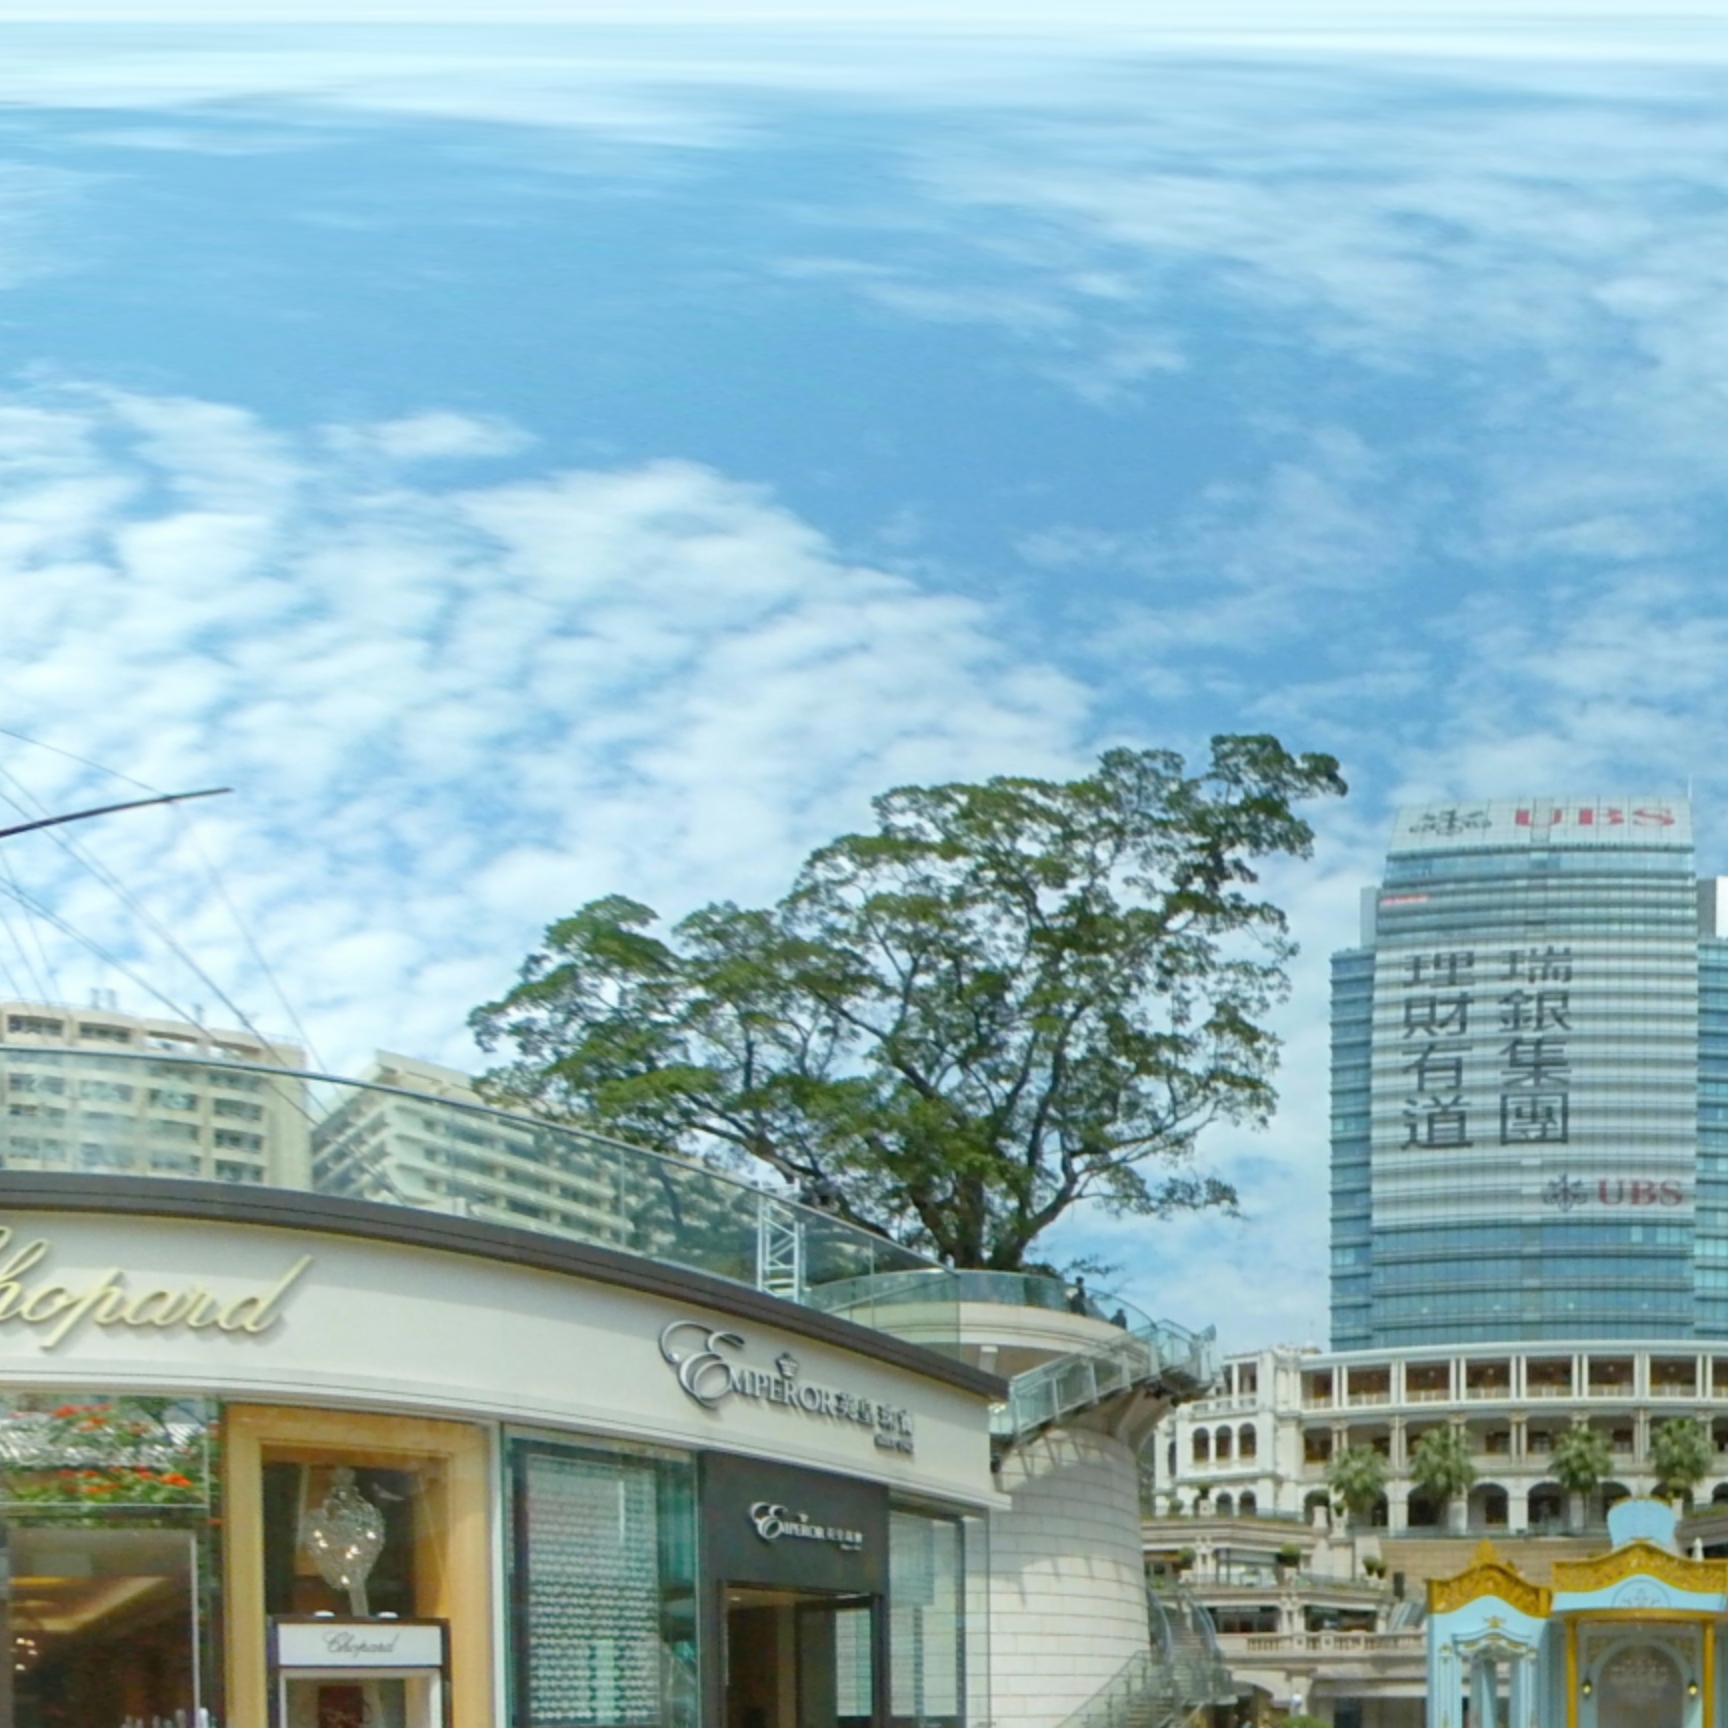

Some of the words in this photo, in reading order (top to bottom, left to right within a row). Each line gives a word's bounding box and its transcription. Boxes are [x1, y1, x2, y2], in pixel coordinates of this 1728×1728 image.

[1514, 807, 1675, 828] UBS
[1400, 951, 1475, 1152] 理財有道
[1499, 945, 1573, 1147] 瑞銀集團
[1597, 1178, 1684, 1207] UBS
[322, 1630, 401, 1658] Chopard
